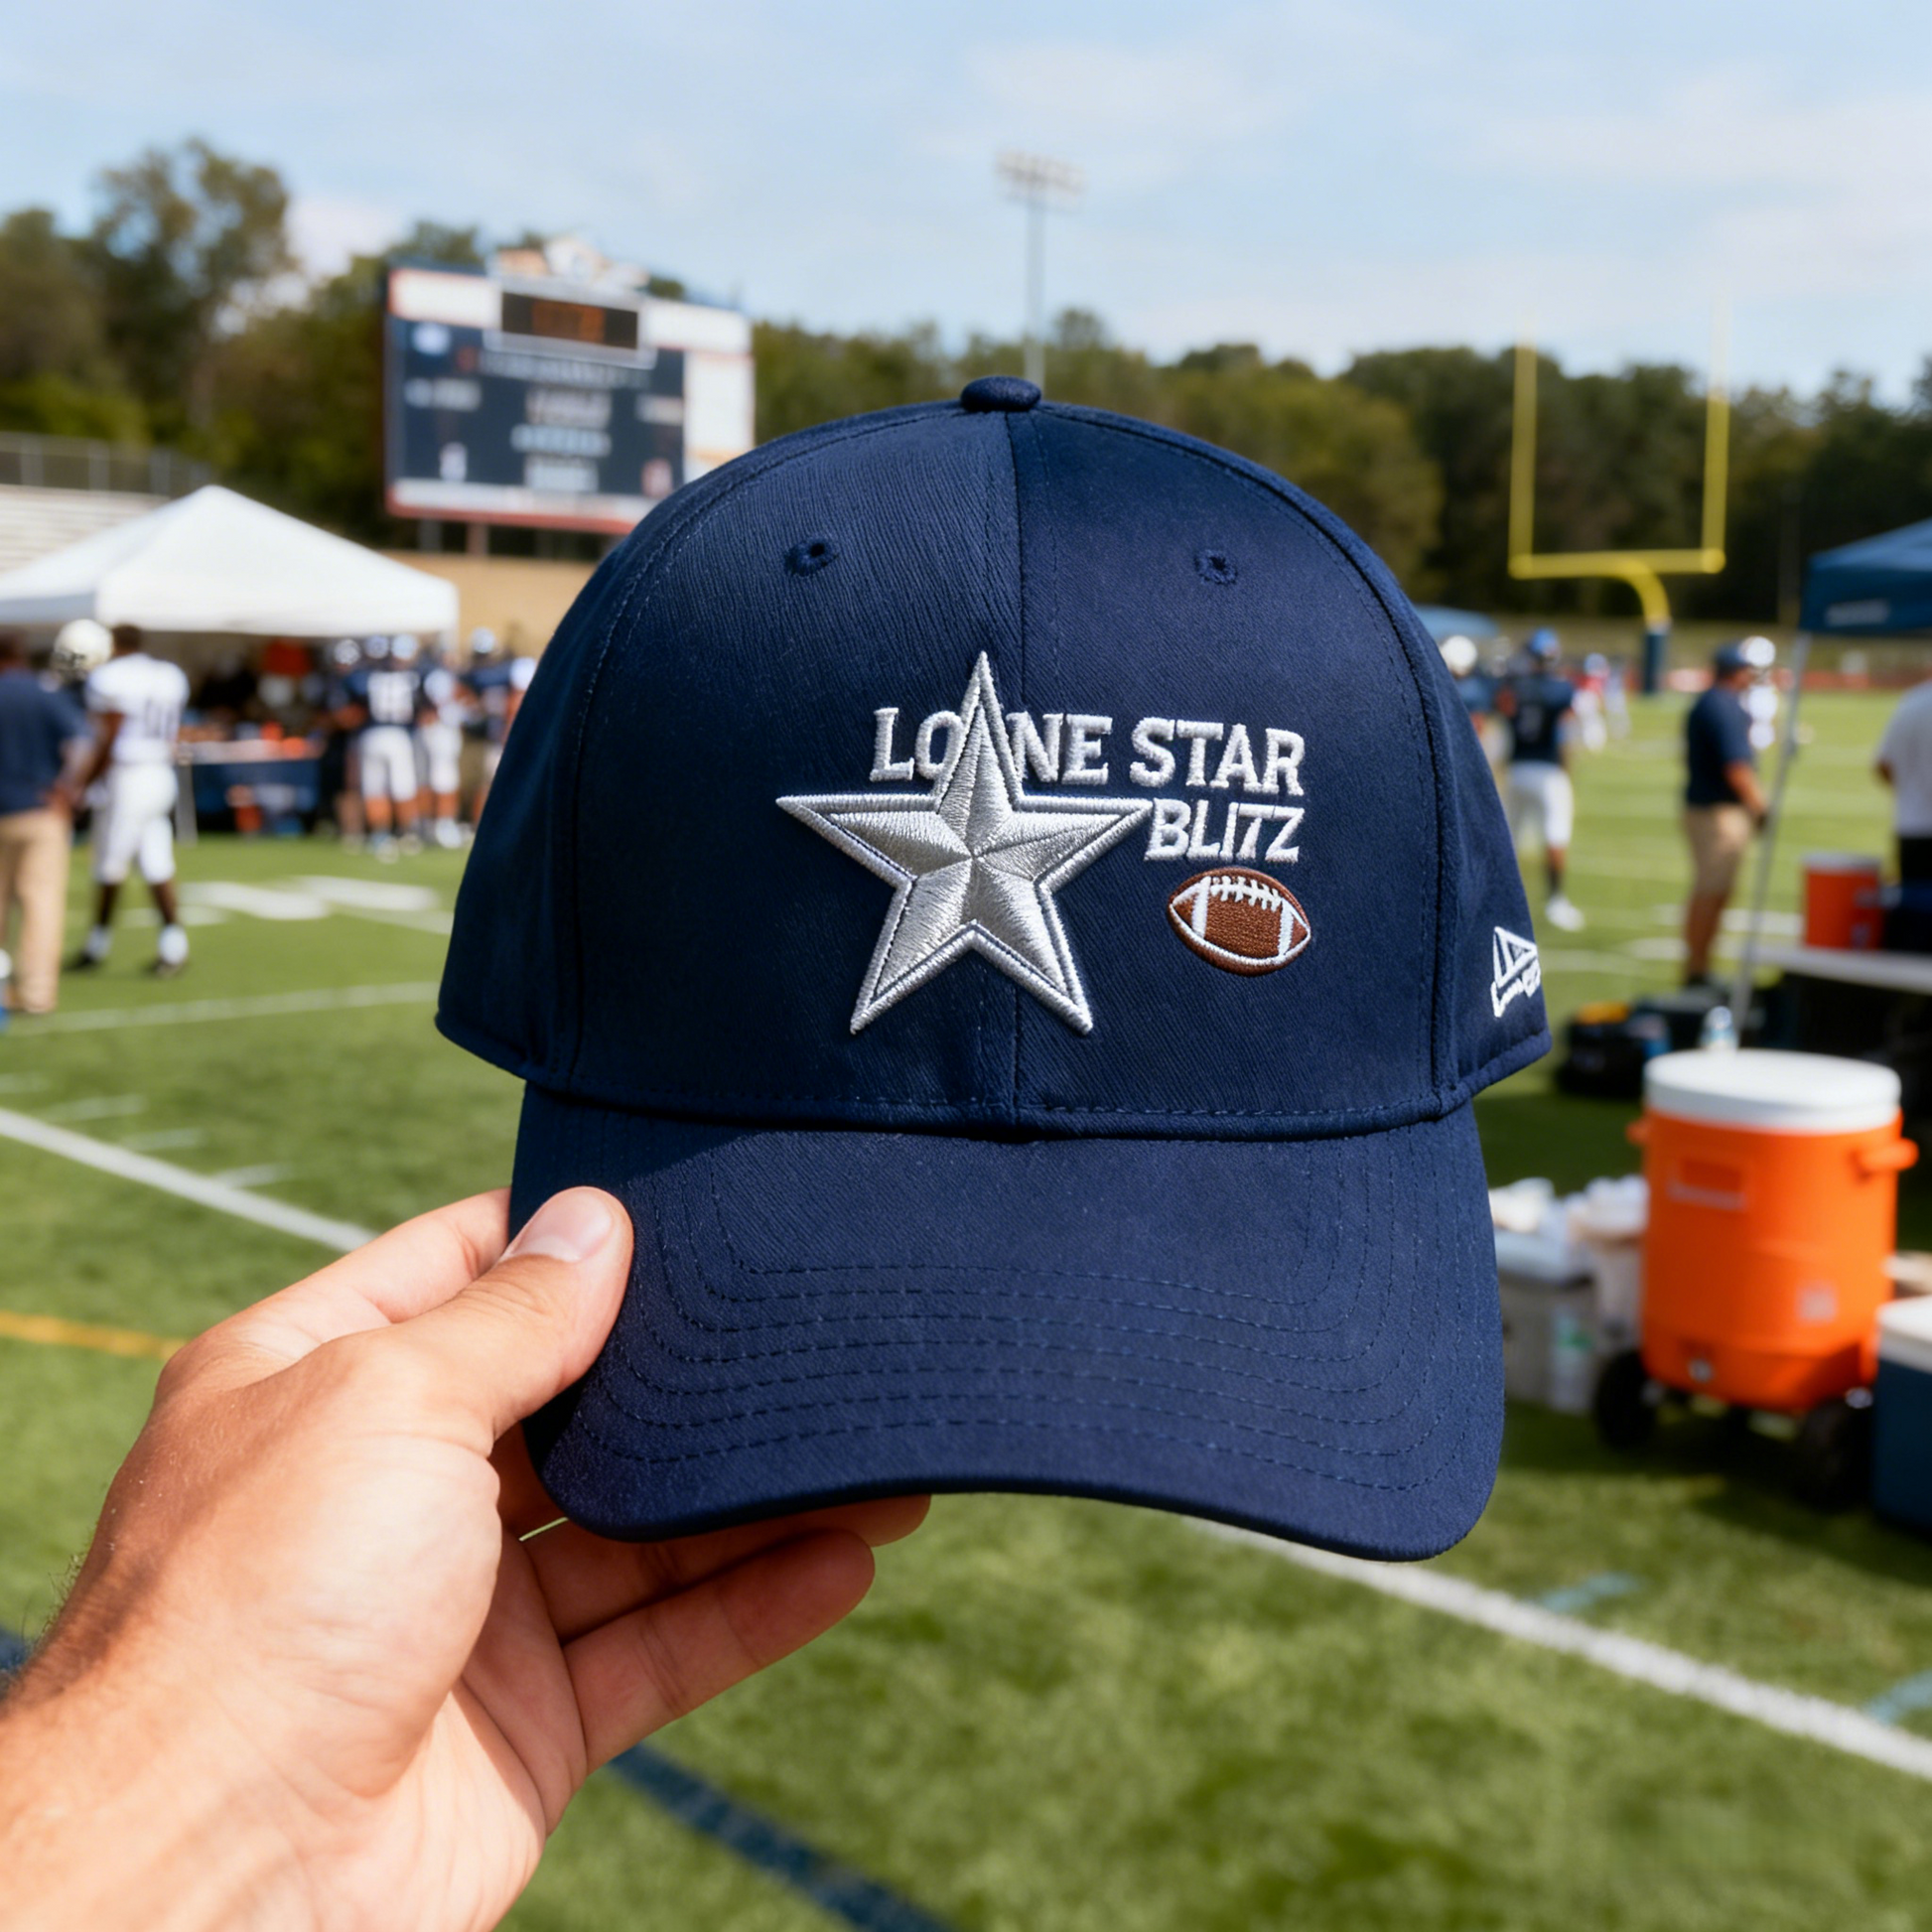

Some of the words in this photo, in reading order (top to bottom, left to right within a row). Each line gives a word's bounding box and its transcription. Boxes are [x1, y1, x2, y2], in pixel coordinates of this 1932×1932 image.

[870, 707, 1113, 785] LONE
[1130, 717, 1305, 796] STAR
[1144, 797, 1306, 863] BLITZ
